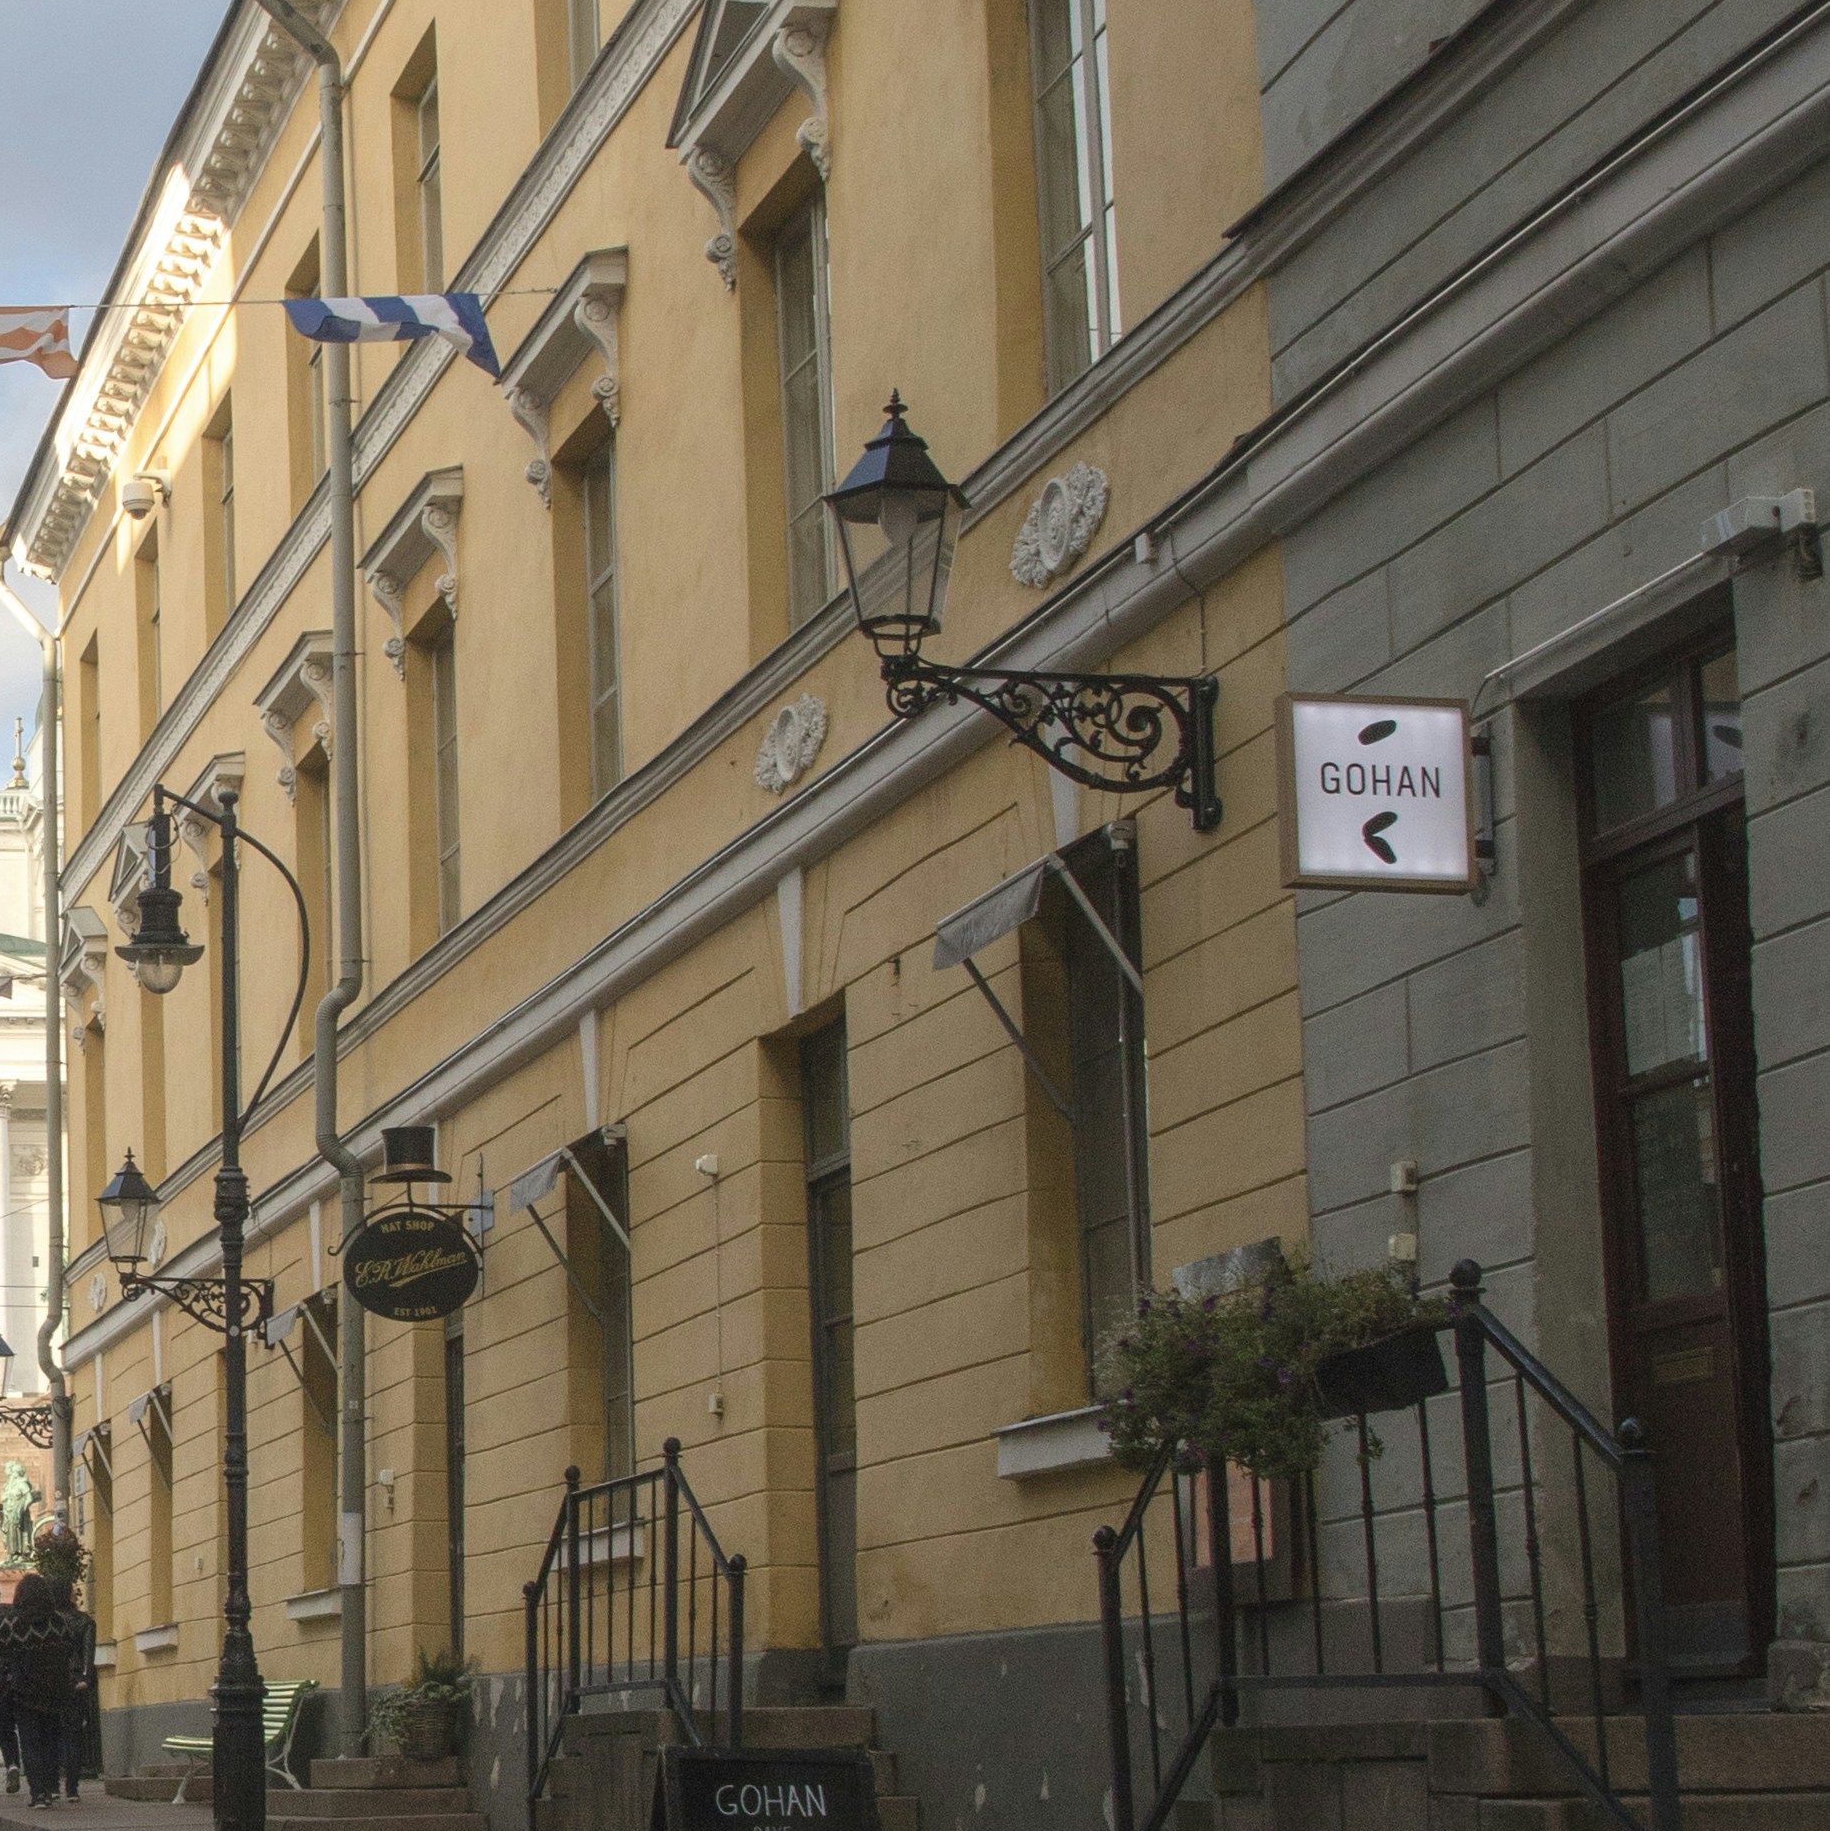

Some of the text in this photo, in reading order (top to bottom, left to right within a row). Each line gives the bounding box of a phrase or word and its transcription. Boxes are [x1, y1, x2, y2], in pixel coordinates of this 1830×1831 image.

[1320, 762, 1441, 798] GOHAN
[381, 1220, 435, 1233] HAT SHOP
[394, 1307, 411, 1316] EST
[716, 1784, 826, 1816] GOHAN
